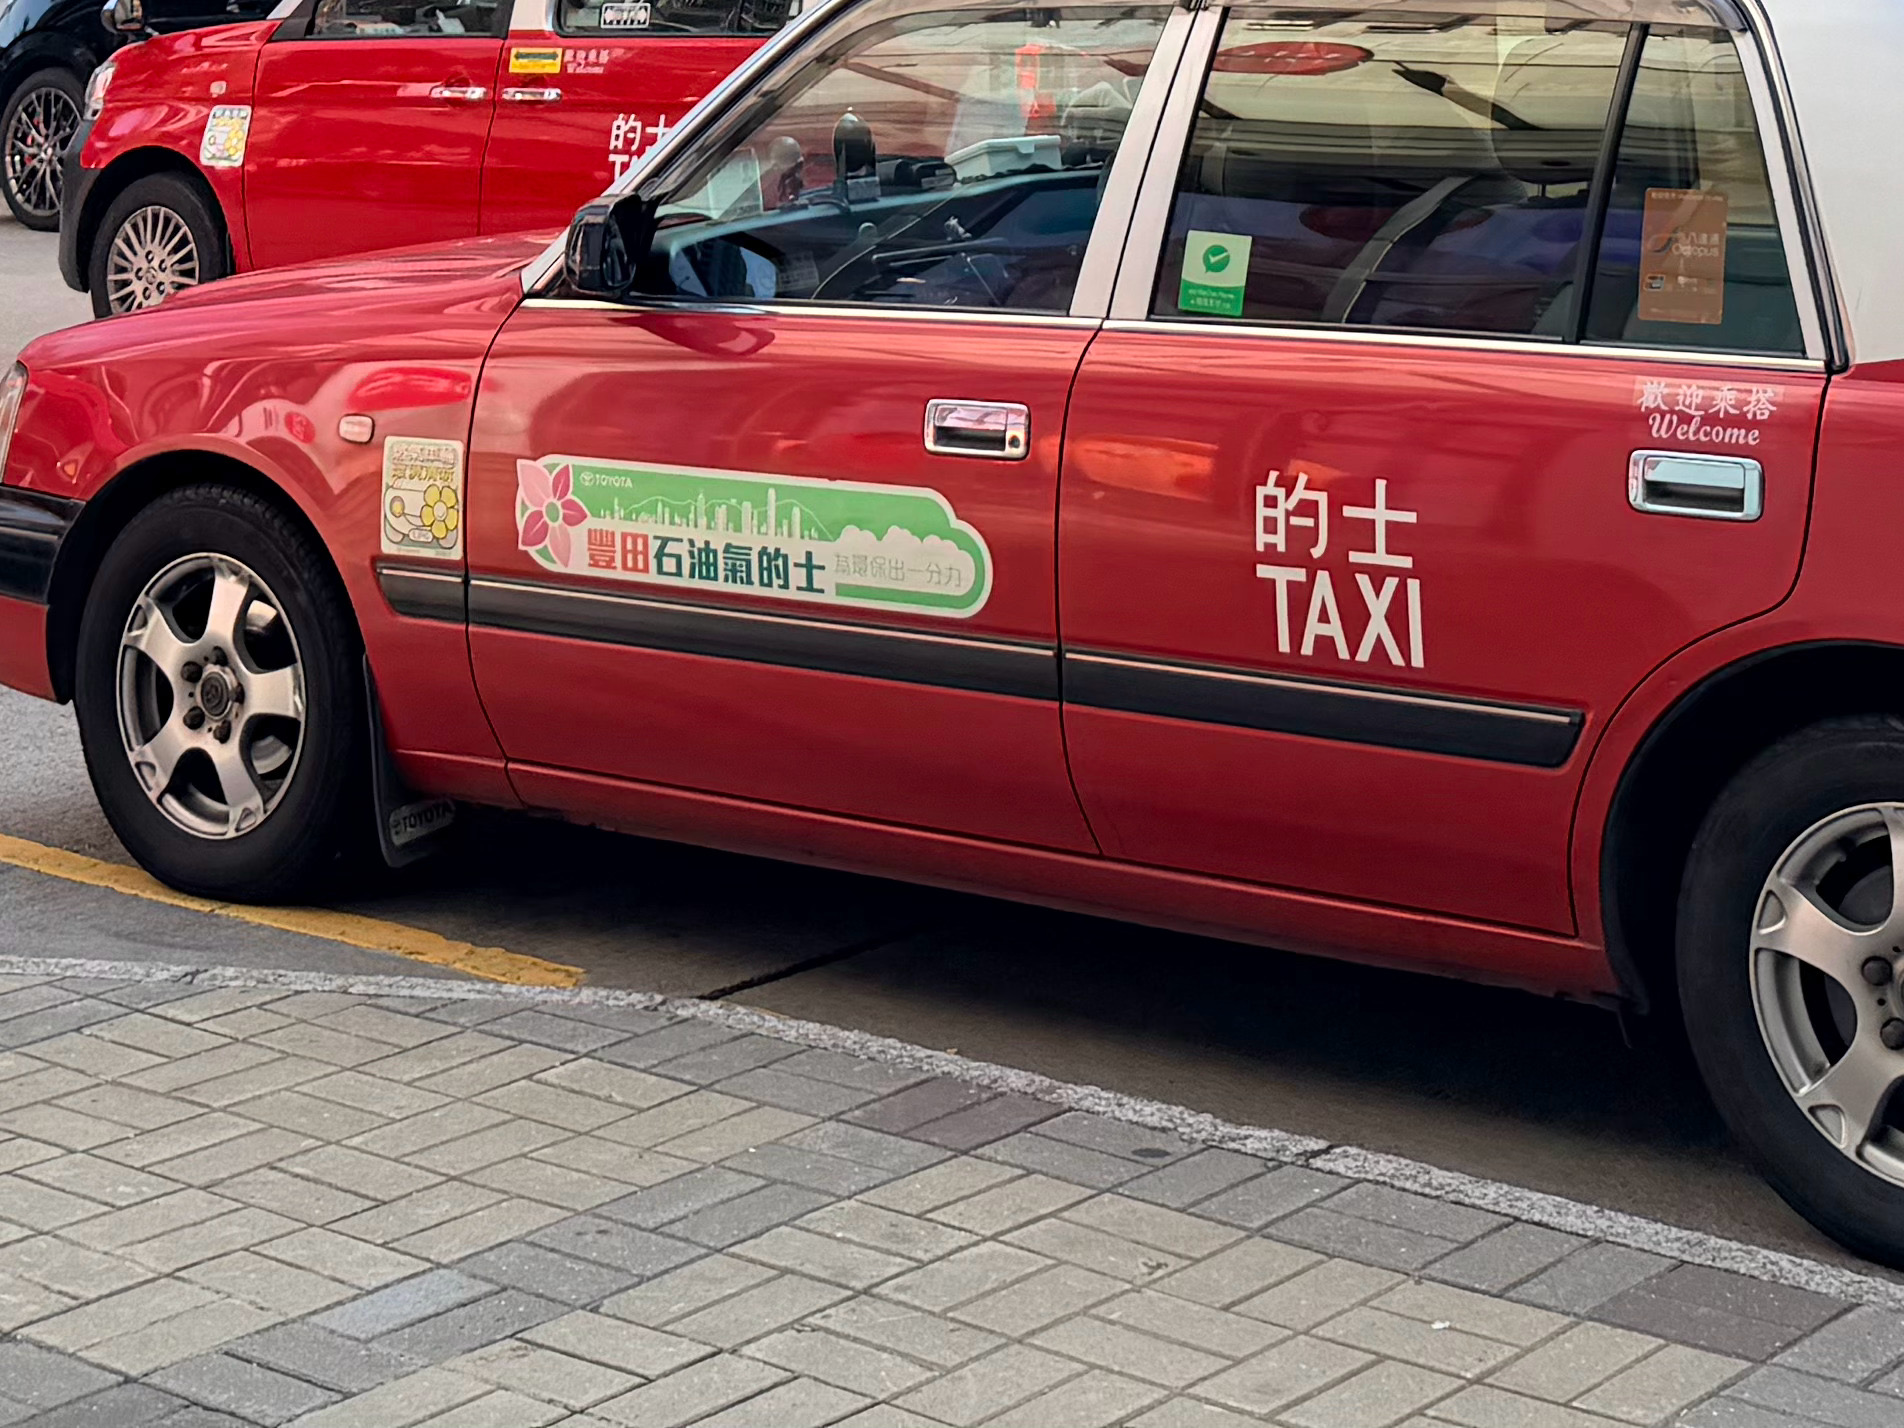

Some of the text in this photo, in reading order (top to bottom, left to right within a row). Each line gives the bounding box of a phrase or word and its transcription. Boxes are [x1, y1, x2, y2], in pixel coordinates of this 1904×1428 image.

[1637, 381, 1777, 421] 歡迎乘搭
[1648, 413, 1760, 446] Welcome
[595, 473, 633, 489] TOYOTA
[1256, 470, 1417, 569] 的士
[587, 528, 826, 594] 豐田石油氣的士
[1256, 563, 1425, 669] TAXI
